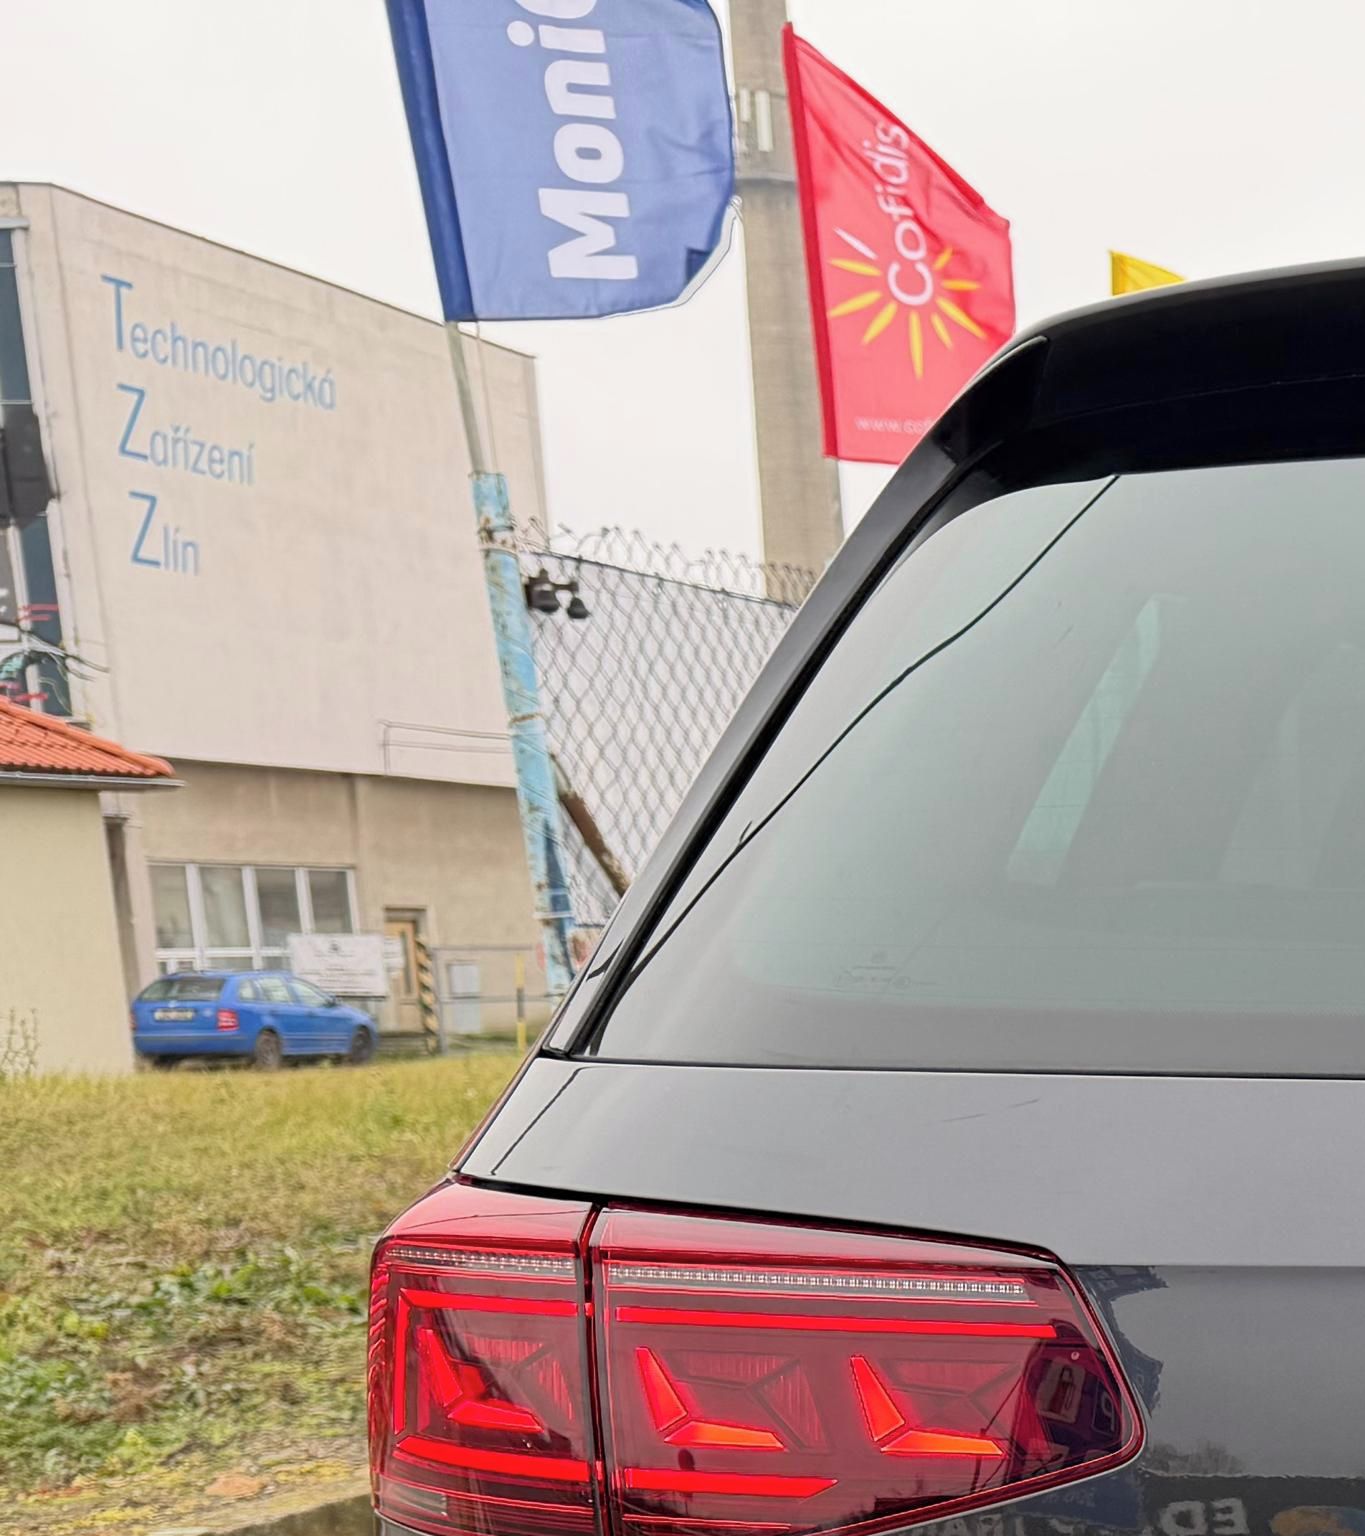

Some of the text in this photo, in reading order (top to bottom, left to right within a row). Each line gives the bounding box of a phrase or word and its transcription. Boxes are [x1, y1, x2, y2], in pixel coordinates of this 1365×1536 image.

[863, 121, 934, 306] Cofidis
[101, 274, 336, 410] Technologická
[116, 382, 255, 487] Zařízení
[128, 490, 200, 577] Zlín
